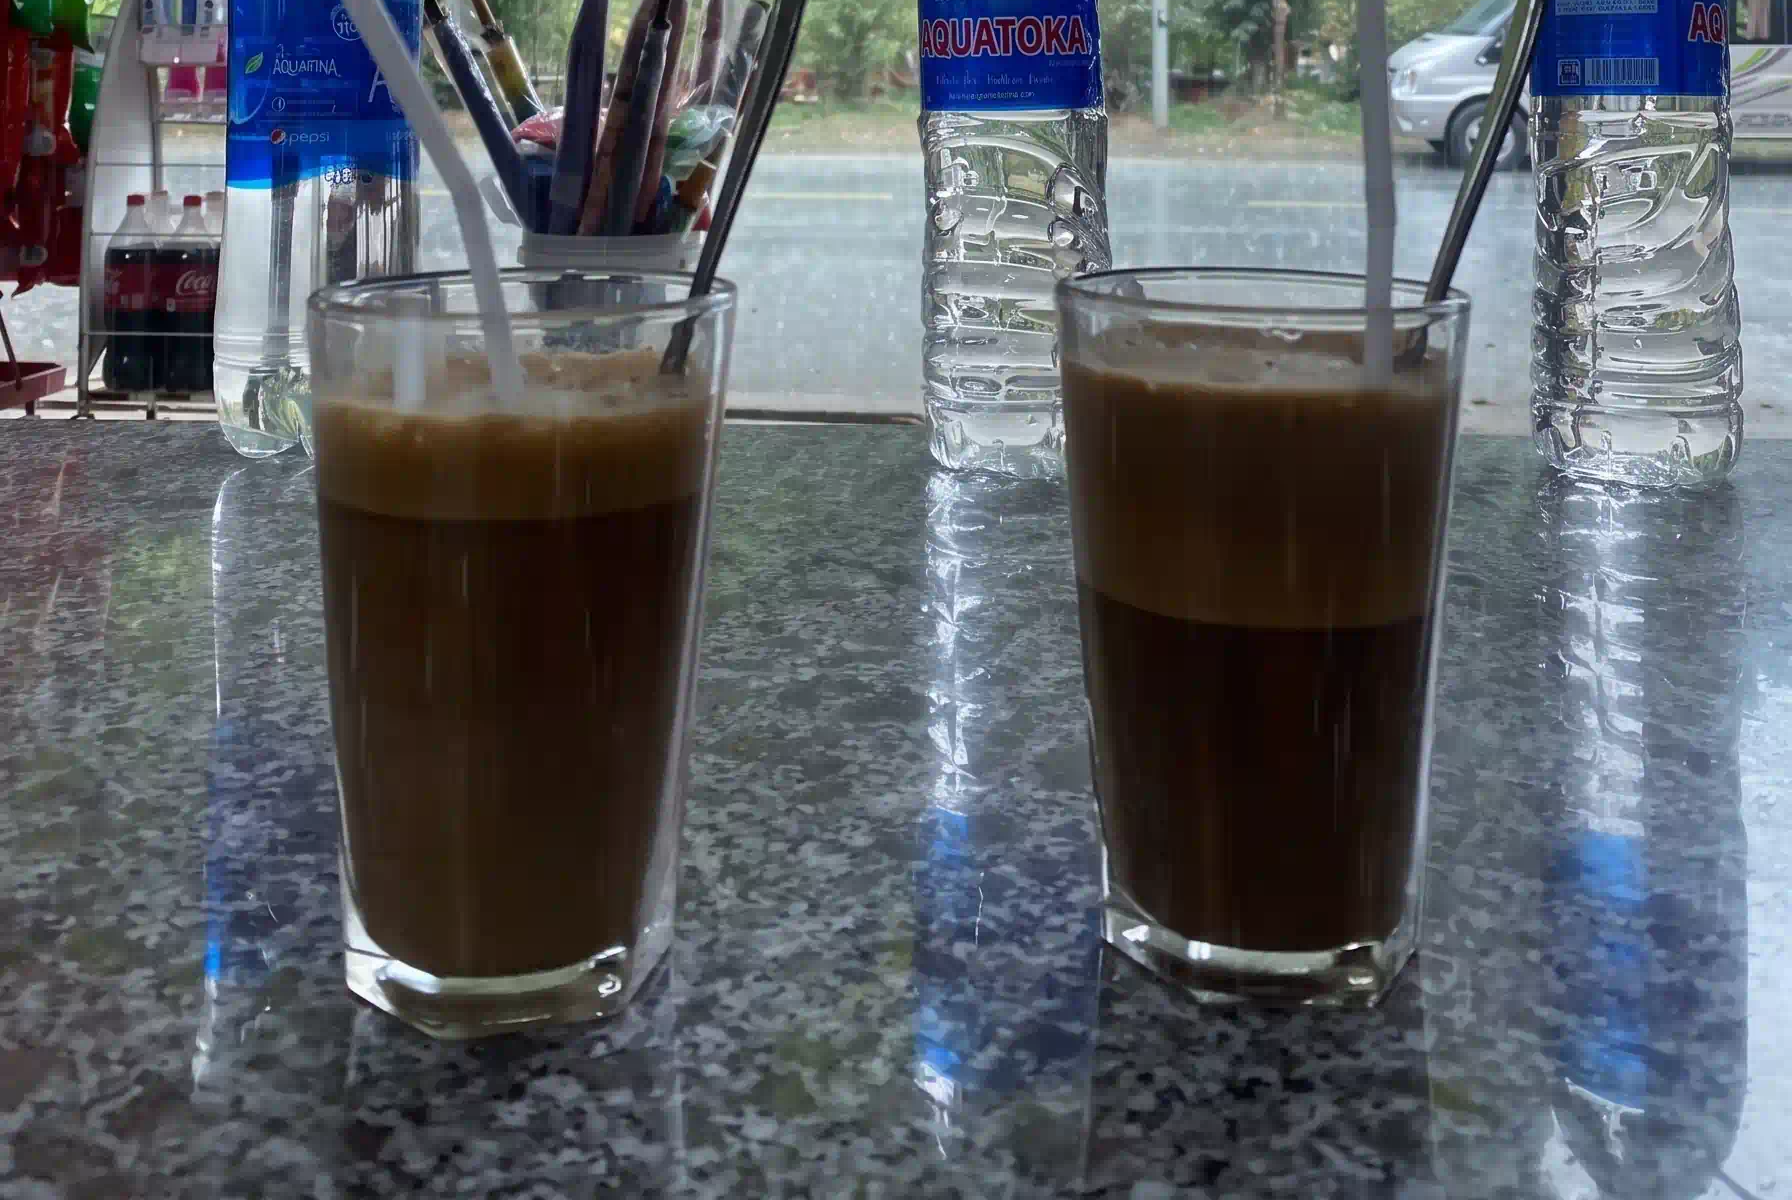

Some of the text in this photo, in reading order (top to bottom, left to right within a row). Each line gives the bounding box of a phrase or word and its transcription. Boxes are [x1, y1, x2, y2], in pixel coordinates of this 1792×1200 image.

[921, 16, 1088, 59] AQUATOKA
[1687, 1, 1727, 45] AQ
[272, 57, 339, 77] AQUAFINA
[289, 131, 330, 146] pepsi
